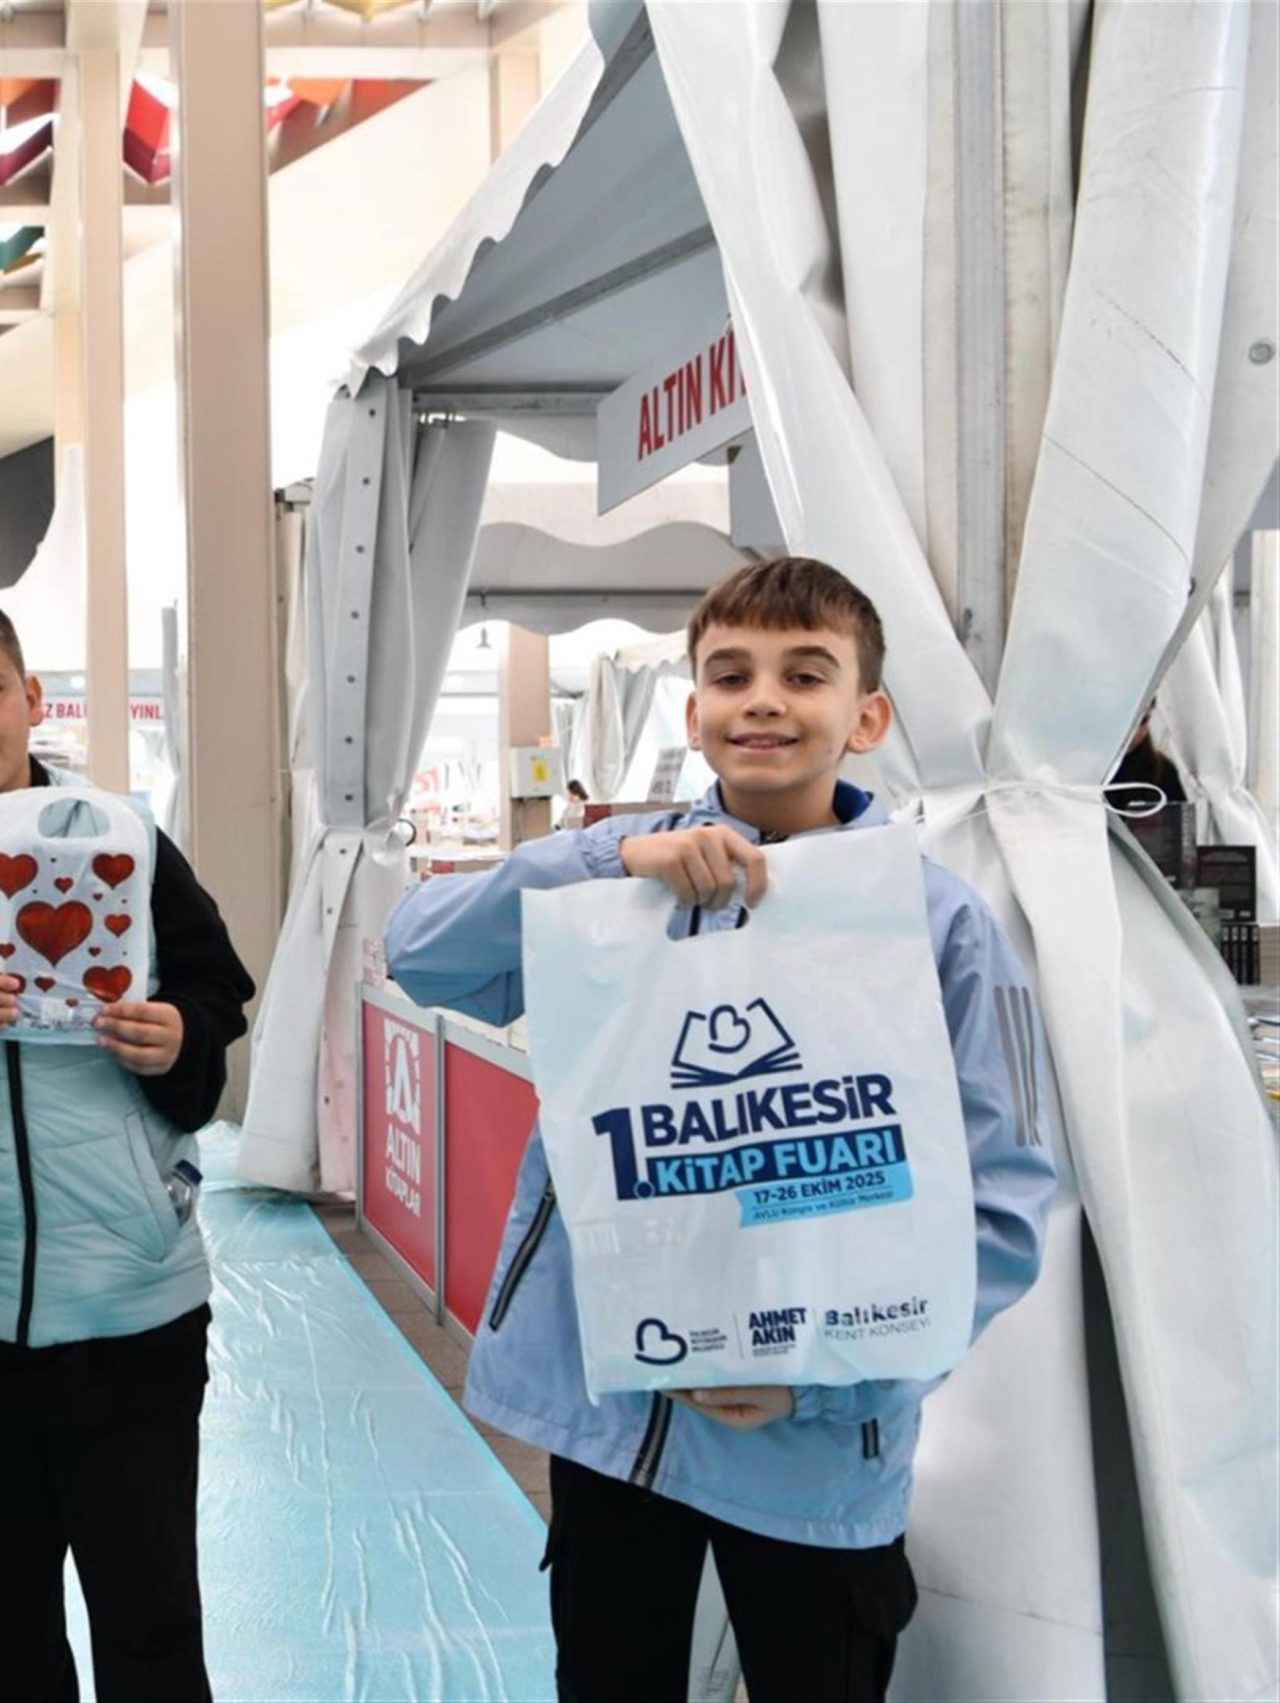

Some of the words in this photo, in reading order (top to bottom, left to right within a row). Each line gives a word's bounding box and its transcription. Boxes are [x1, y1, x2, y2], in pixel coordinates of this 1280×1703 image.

[638, 353, 703, 462] ALTIN
[385, 1122, 421, 1185] ALTIN
[774, 1129, 898, 1178] FUARI
[754, 1185, 798, 1205] 17-26
[801, 1177, 842, 1199] EKİM
[846, 1170, 887, 1190] 2025
[748, 1306, 807, 1330] AHMET
[751, 1324, 797, 1347] AKIN
